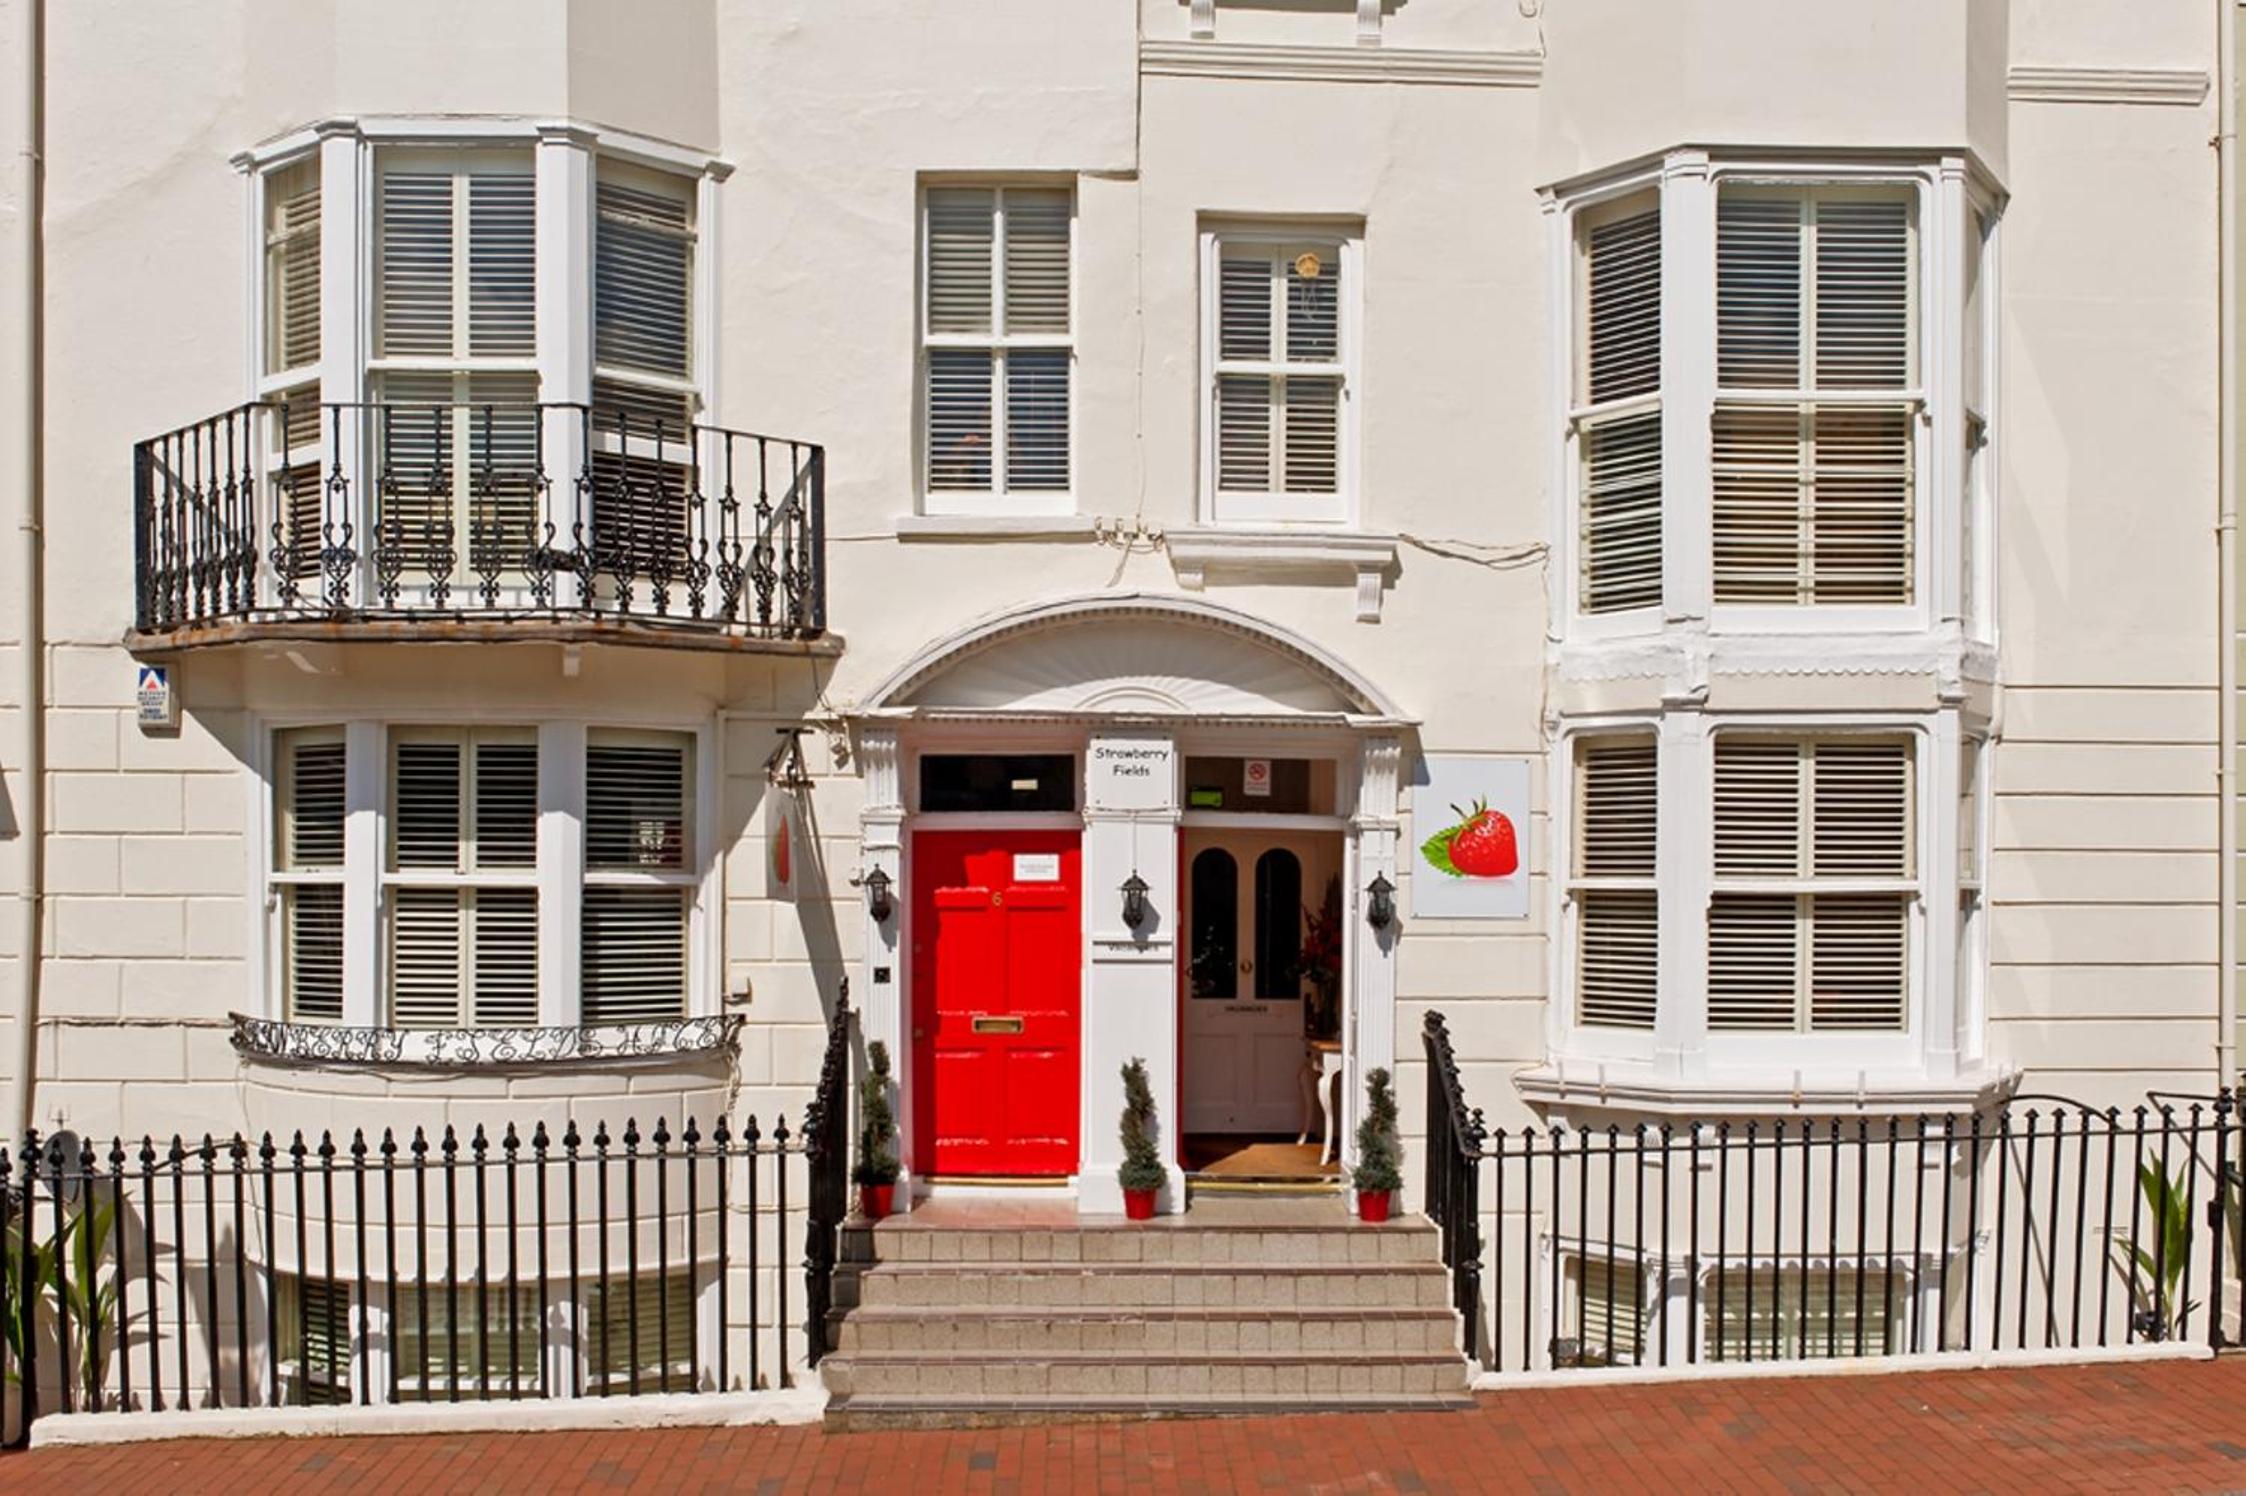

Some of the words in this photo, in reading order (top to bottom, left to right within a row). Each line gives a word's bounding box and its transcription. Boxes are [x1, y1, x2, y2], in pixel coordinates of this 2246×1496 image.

[1095, 746, 1169, 761] Strawberry
[1112, 764, 1151, 777] Fields
[991, 890, 1004, 907] 6
